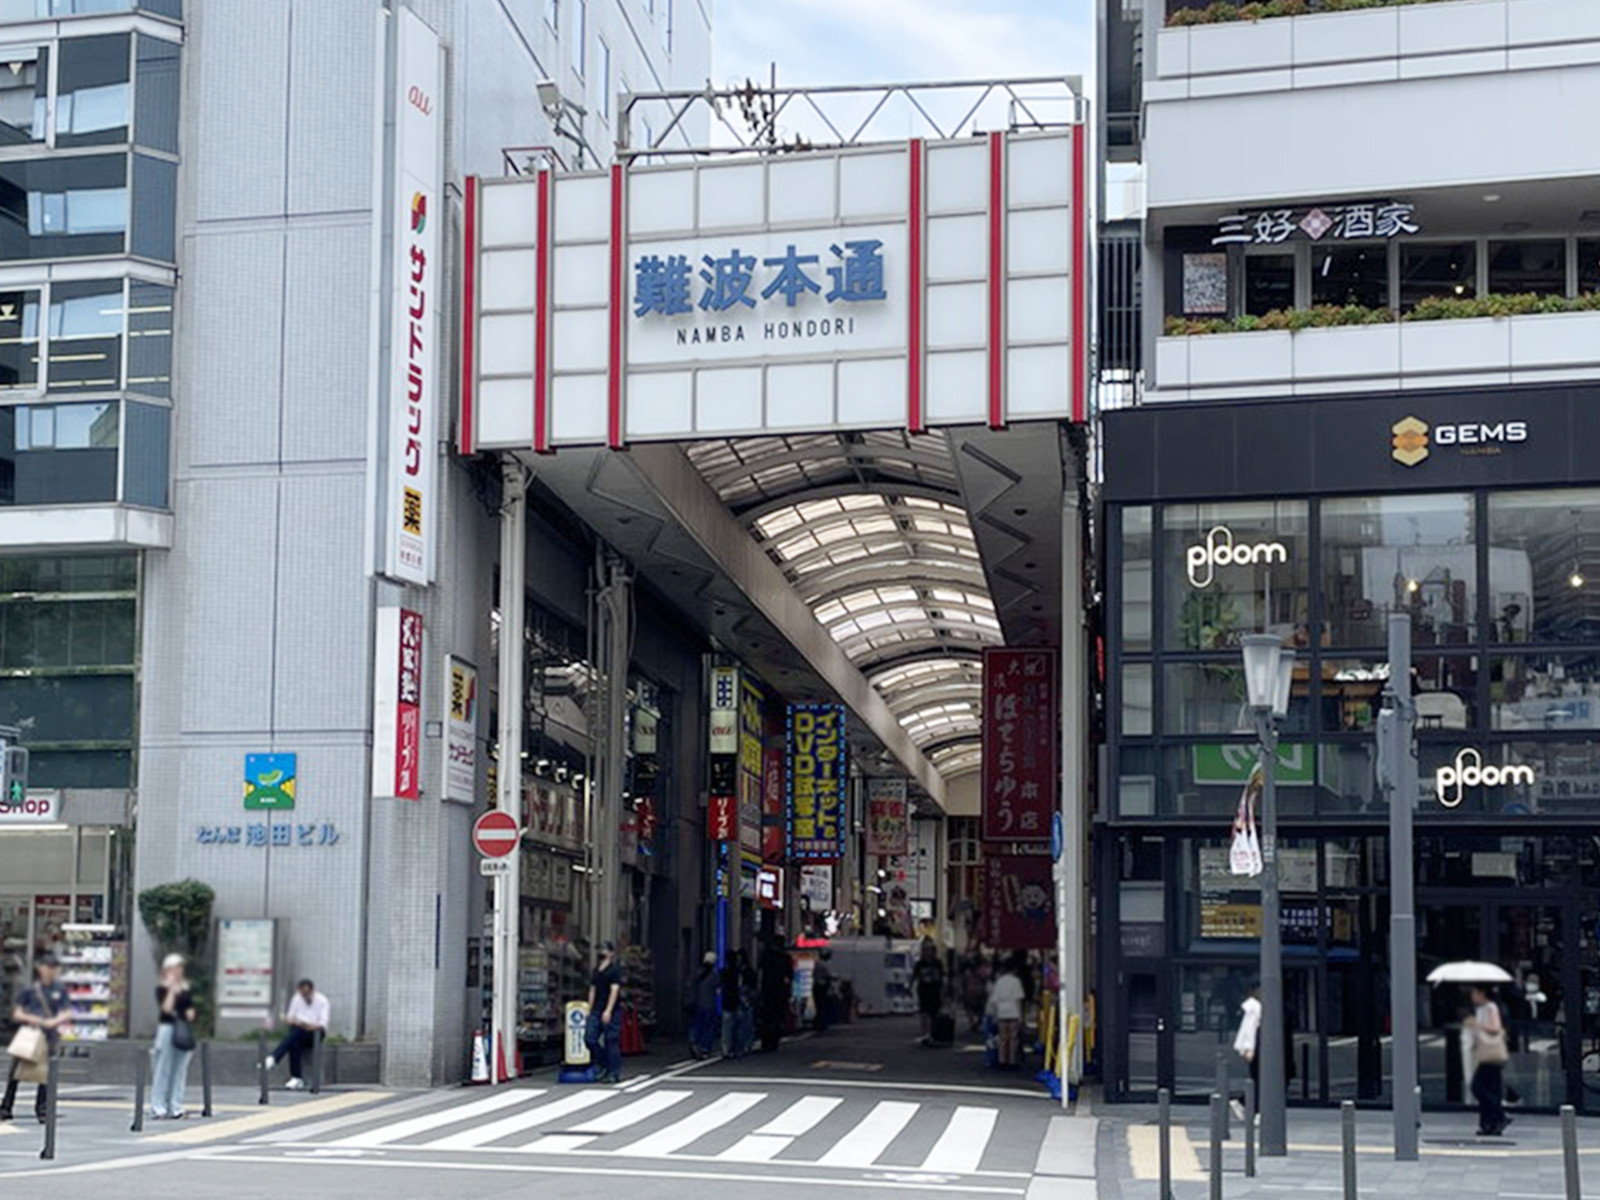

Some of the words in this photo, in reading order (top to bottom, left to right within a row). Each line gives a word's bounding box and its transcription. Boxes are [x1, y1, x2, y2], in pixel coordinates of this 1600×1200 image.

[1211, 209, 1297, 246] 三好
[1334, 202, 1420, 239] 酒家
[633, 239, 888, 318] 難波本通
[404, 243, 428, 477] サンドラッグ
[676, 325, 745, 346] NAMBA
[764, 317, 855, 340] HONDORI
[1434, 421, 1528, 445] GEMS
[1187, 525, 1287, 588] ploom
[1436, 748, 1534, 808] ploom
